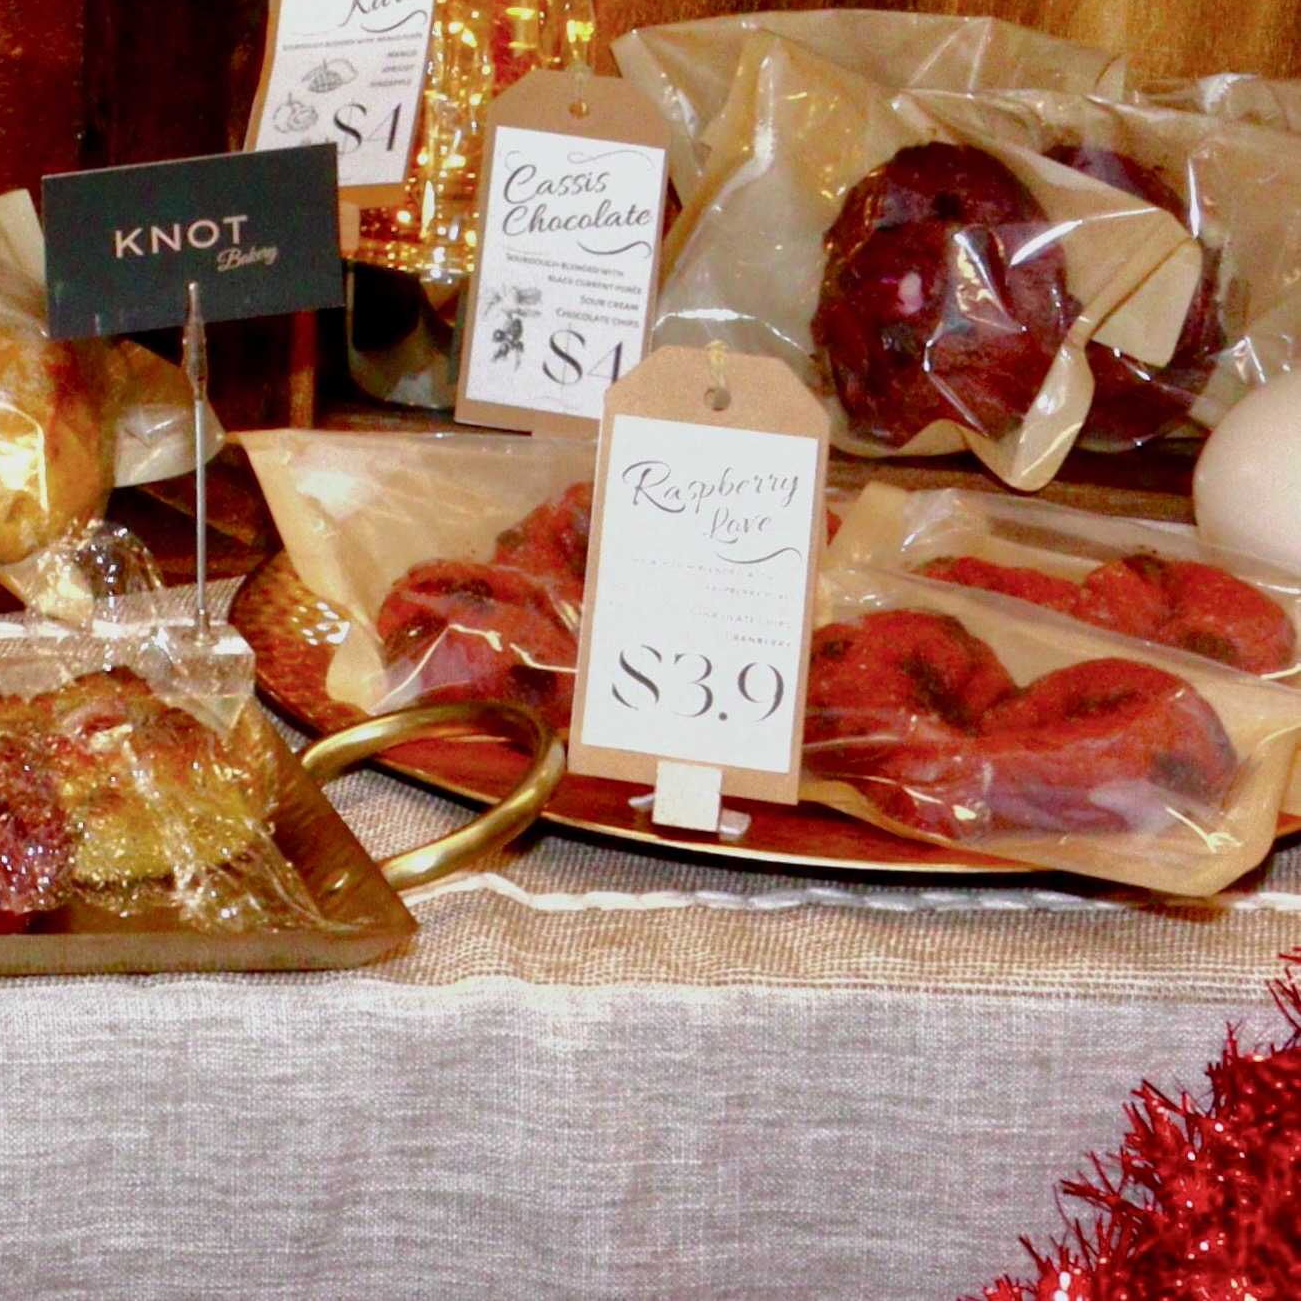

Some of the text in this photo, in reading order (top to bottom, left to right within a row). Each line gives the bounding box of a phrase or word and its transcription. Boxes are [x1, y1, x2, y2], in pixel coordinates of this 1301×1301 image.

[503, 163, 610, 205] Cassis
[114, 215, 248, 259] KNOT
[502, 199, 650, 236] Chocolate
[216, 245, 279, 272] Bakery
[542, 327, 622, 387] $4
[622, 460, 799, 513] Raspberry
[611, 644, 785, 724] $3.9
